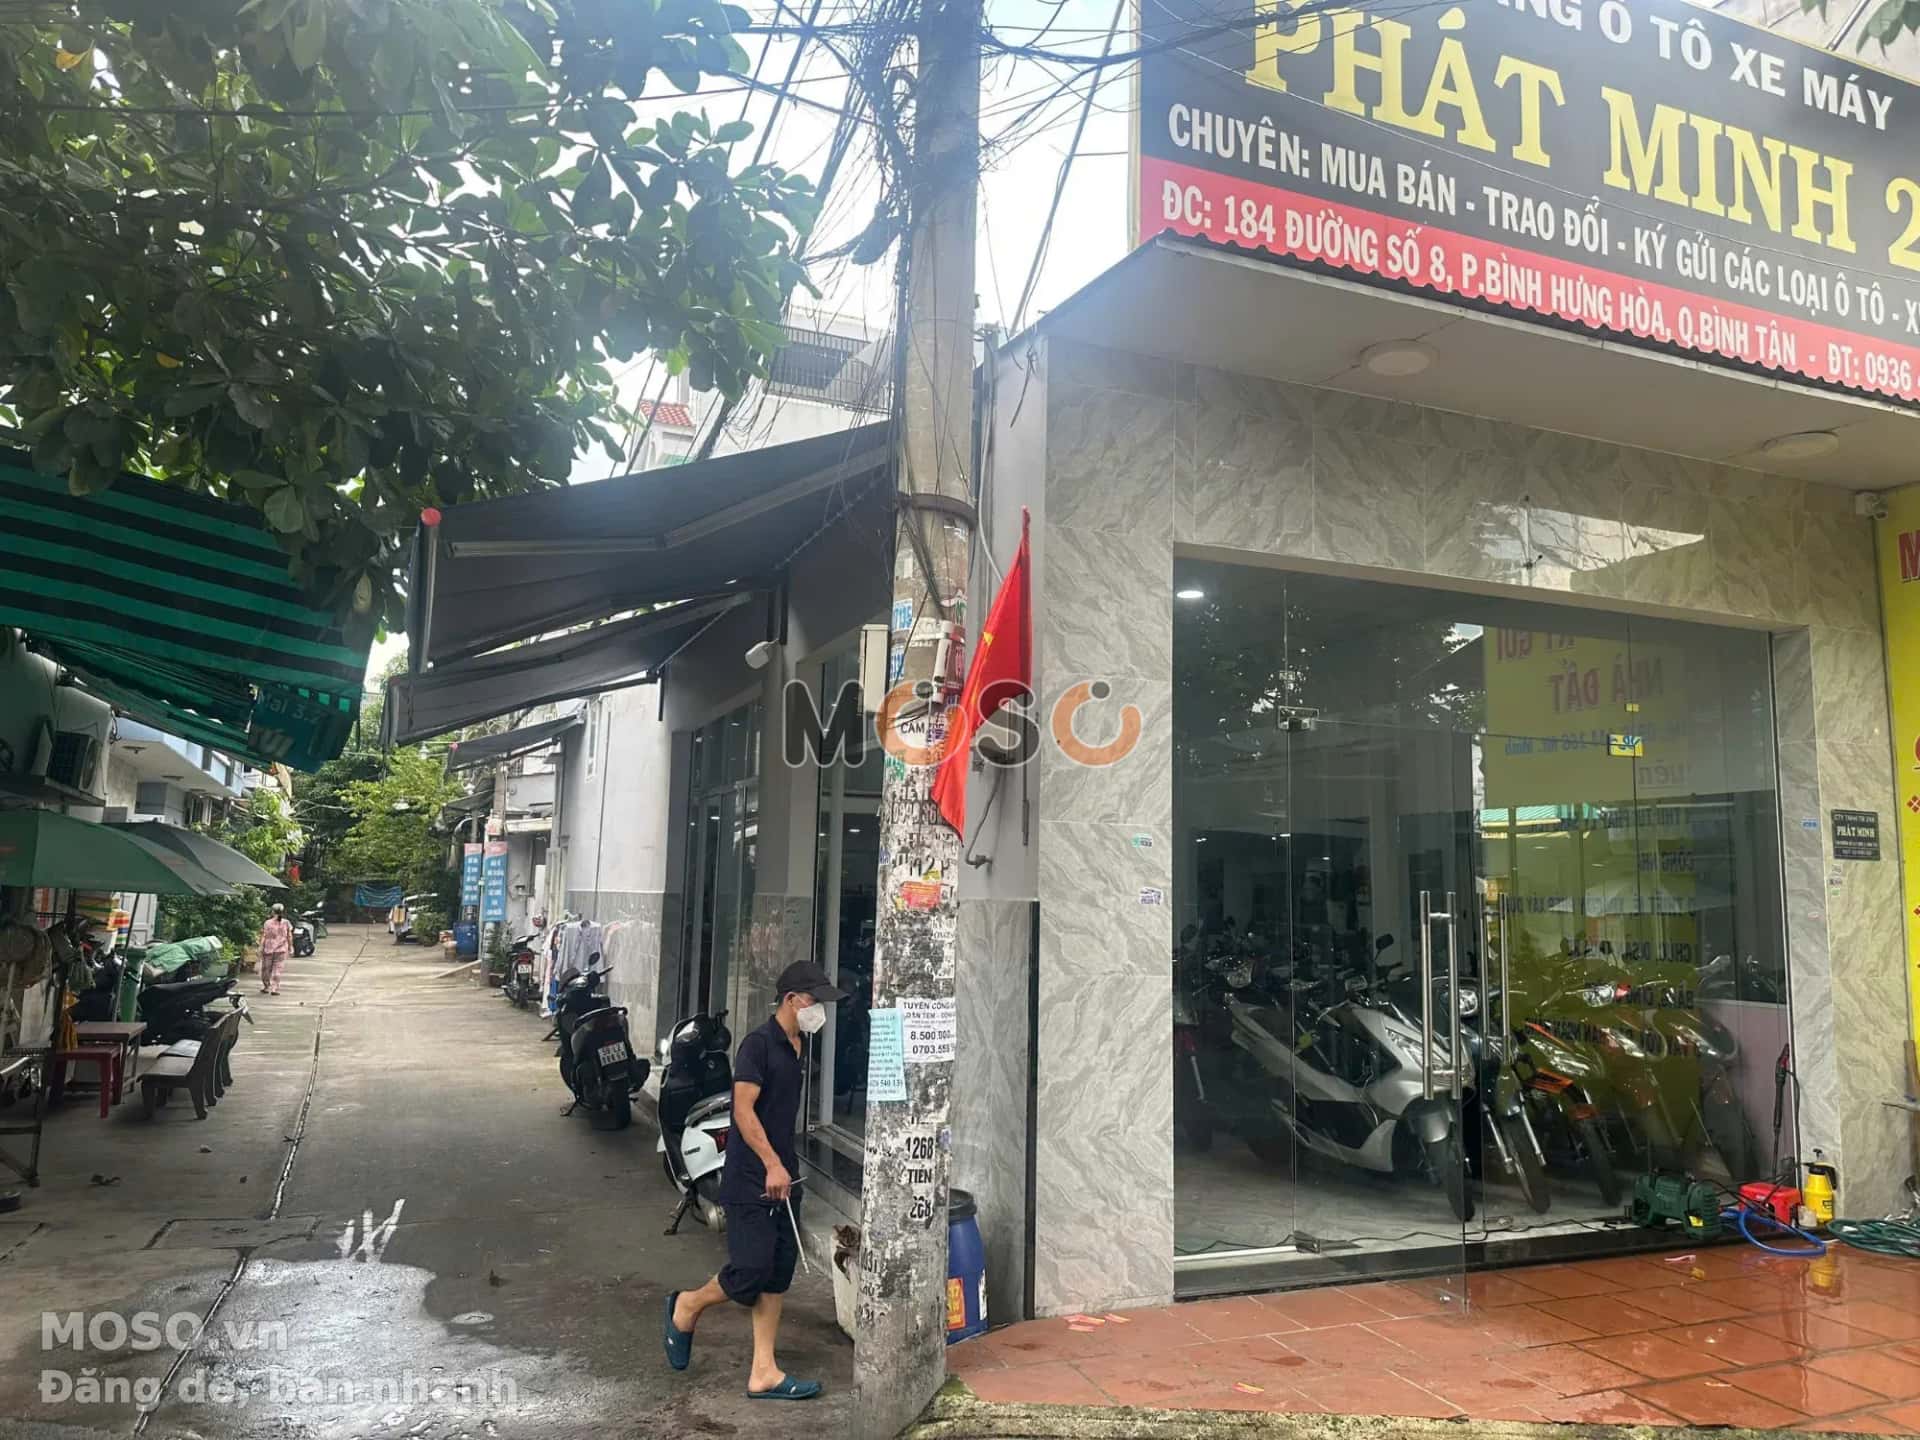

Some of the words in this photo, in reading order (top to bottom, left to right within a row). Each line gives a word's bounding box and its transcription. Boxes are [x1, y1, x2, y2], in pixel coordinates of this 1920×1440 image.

[1245, 0, 1566, 168] PHÁT
[1601, 86, 1857, 254] MINH
[1649, 14, 1713, 71] TÔ
[1730, 42, 1786, 97] XE
[1803, 67, 1894, 131] MÁY
[1162, 180, 1212, 230] ĐC:
[1224, 195, 1277, 243] 184
[1284, 209, 1379, 269] ĐƯỜNG
[1386, 226, 1422, 278] SỐ
[1429, 245, 1453, 293] 8,
[1461, 252, 1543, 308] P.BÌNH
[1551, 274, 1613, 331] HƯNG
[1620, 286, 1672, 339] HÒA,
[1678, 306, 1749, 356] Q.BÌNH
[1755, 319, 1797, 366] TÂN
[1827, 342, 1860, 381] ĐT:
[1865, 350, 1912, 392] 0936
[1168, 103, 1310, 179] CHUYÊN:
[1321, 142, 1388, 199] MUA
[1397, 159, 1456, 217] BÁN
[1483, 186, 1556, 241] TRAO
[1563, 195, 1609, 256] ĐỔI
[1634, 223, 1667, 270] KÝ
[1676, 231, 1718, 284] GỬI
[1724, 247, 1771, 297] CÁC
[1777, 265, 1829, 317] LOẠI
[1834, 271, 1850, 317] Ô
[1855, 281, 1885, 325] TÔ
